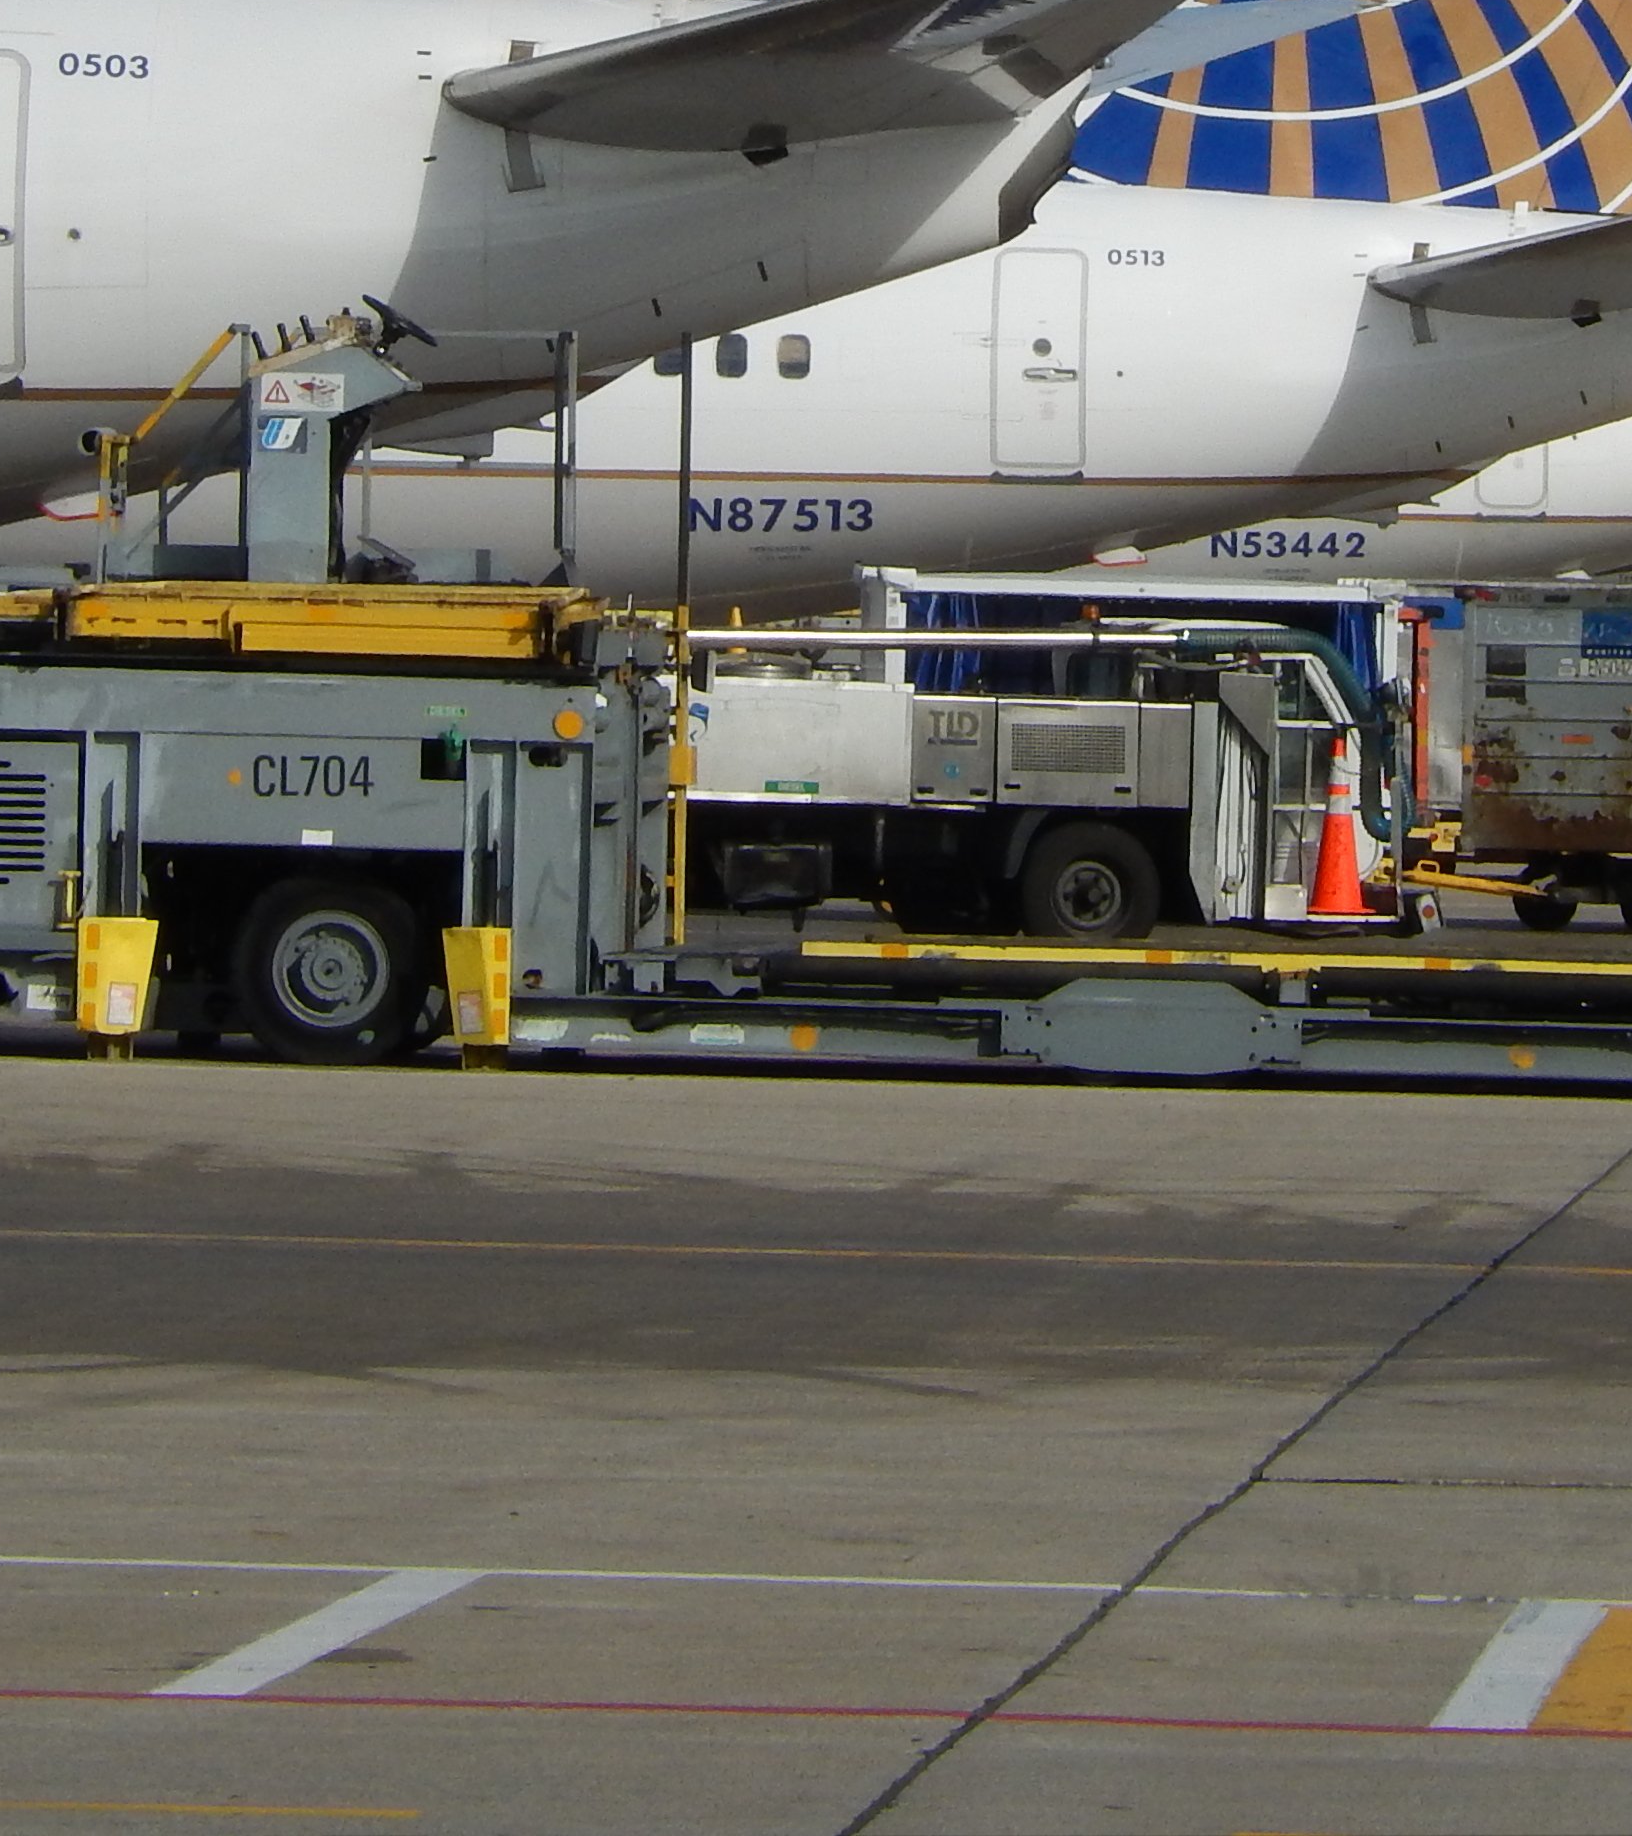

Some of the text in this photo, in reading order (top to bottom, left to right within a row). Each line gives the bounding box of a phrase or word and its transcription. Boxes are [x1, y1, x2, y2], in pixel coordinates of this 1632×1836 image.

[58, 52, 149, 79] 0503
[1107, 248, 1165, 267] 0513
[688, 497, 874, 533] N87513
[1210, 530, 1366, 559] N53442
[928, 710, 979, 738] TLD
[253, 754, 375, 797] CL704
